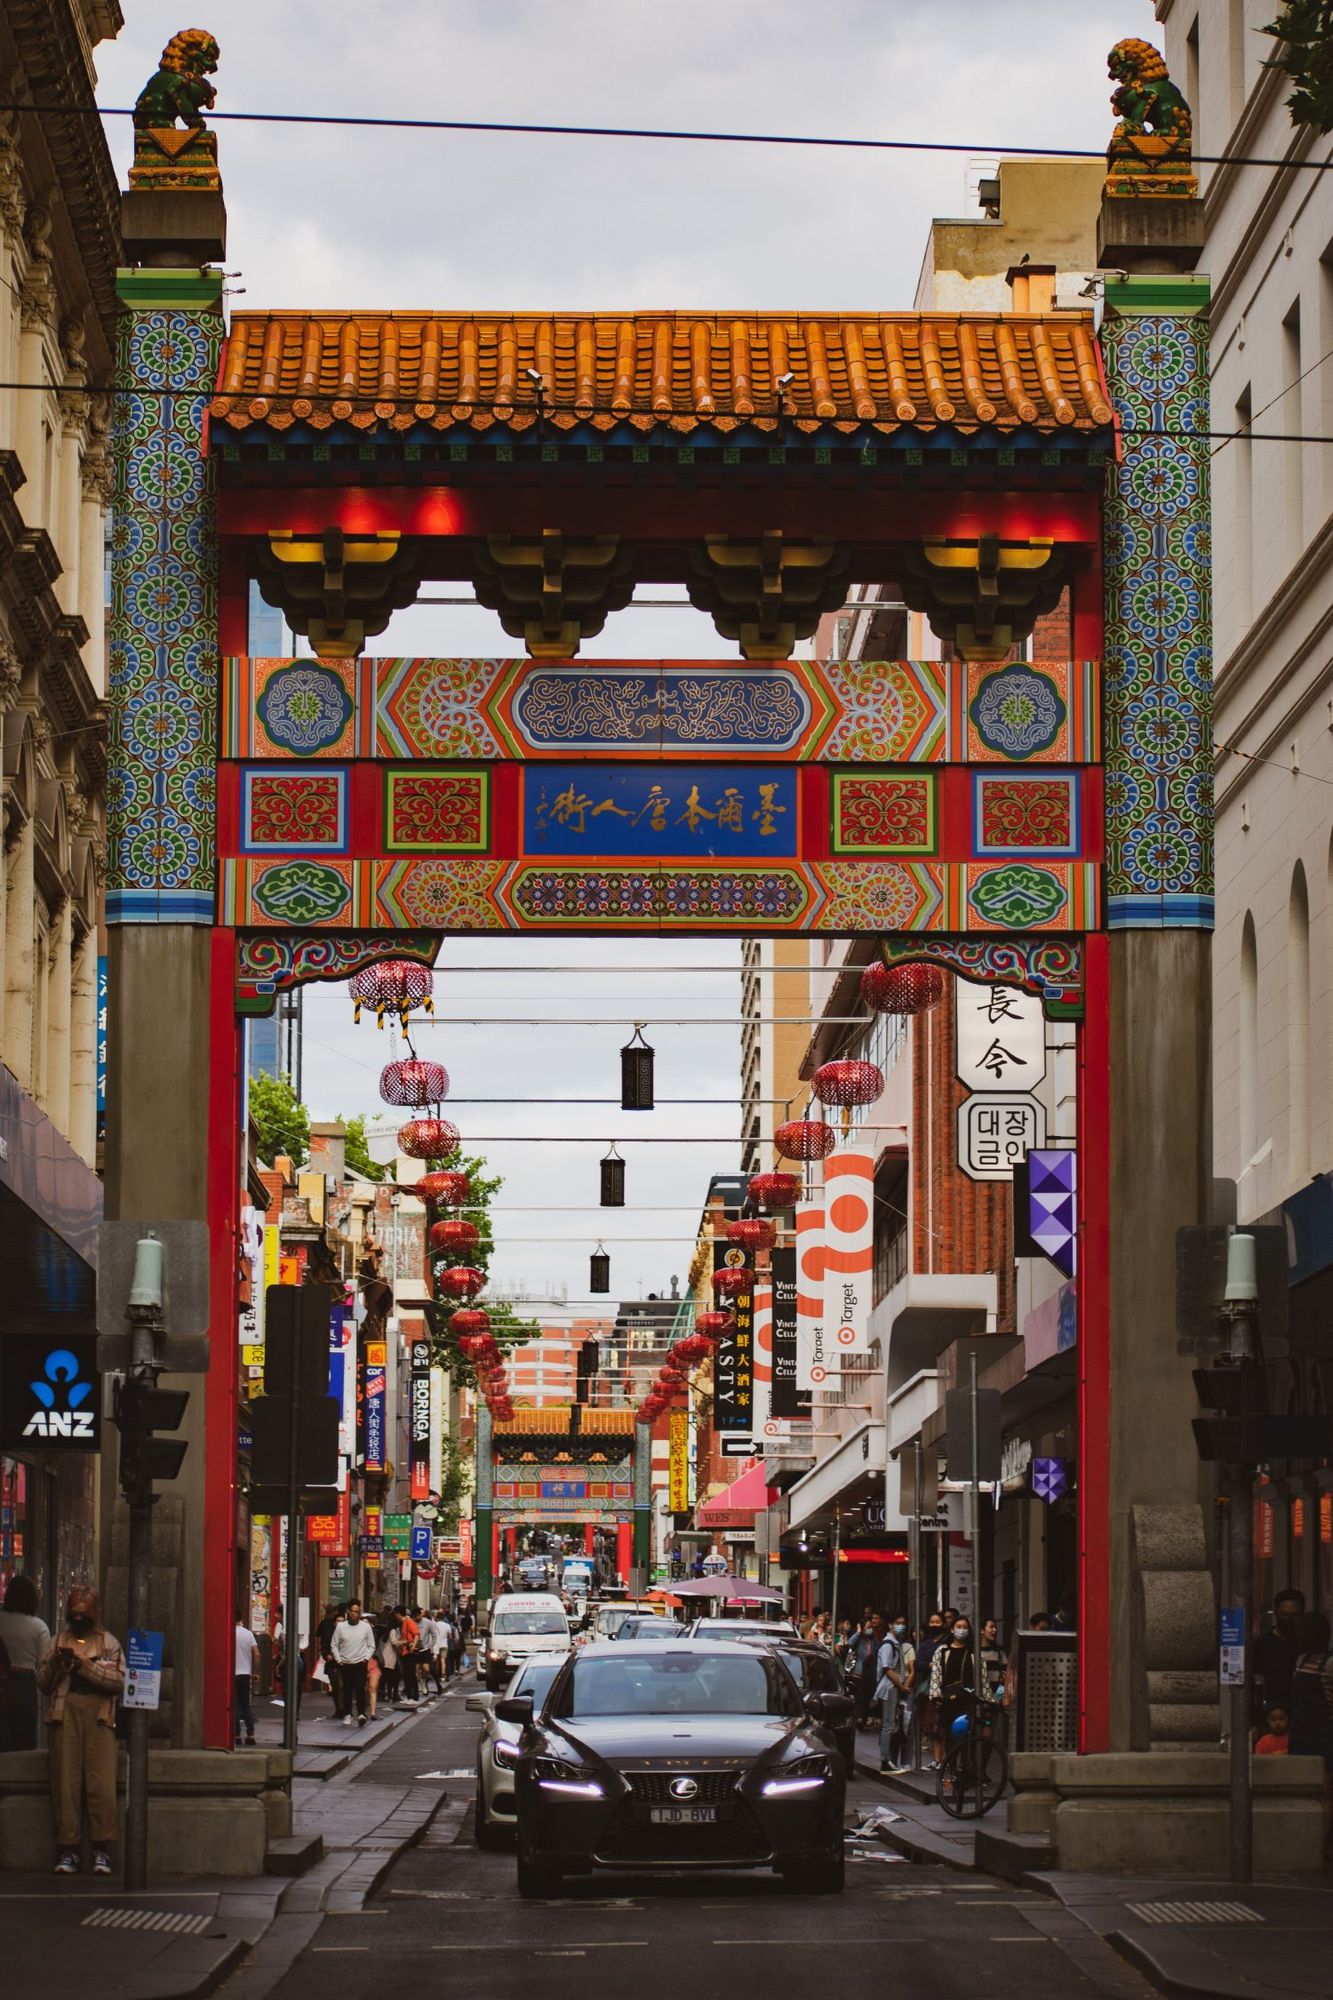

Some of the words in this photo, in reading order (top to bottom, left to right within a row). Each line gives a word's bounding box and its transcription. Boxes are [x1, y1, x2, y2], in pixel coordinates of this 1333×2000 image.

[375, 1227, 418, 1248] TORIA
[841, 1283, 857, 1324] Target
[252, 1345, 264, 1362] ice
[719, 1282, 735, 1404] YASTY
[737, 1294, 751, 1406] 朝海鮮大酒家
[813, 1327, 823, 1364] Target
[416, 1379, 429, 1441] BORNGA
[22, 1411, 95, 1437] ANZ
[239, 1436, 252, 1444] tte
[704, 1513, 740, 1523] WES
[937, 1503, 948, 1514] et
[416, 1531, 428, 1544] P
